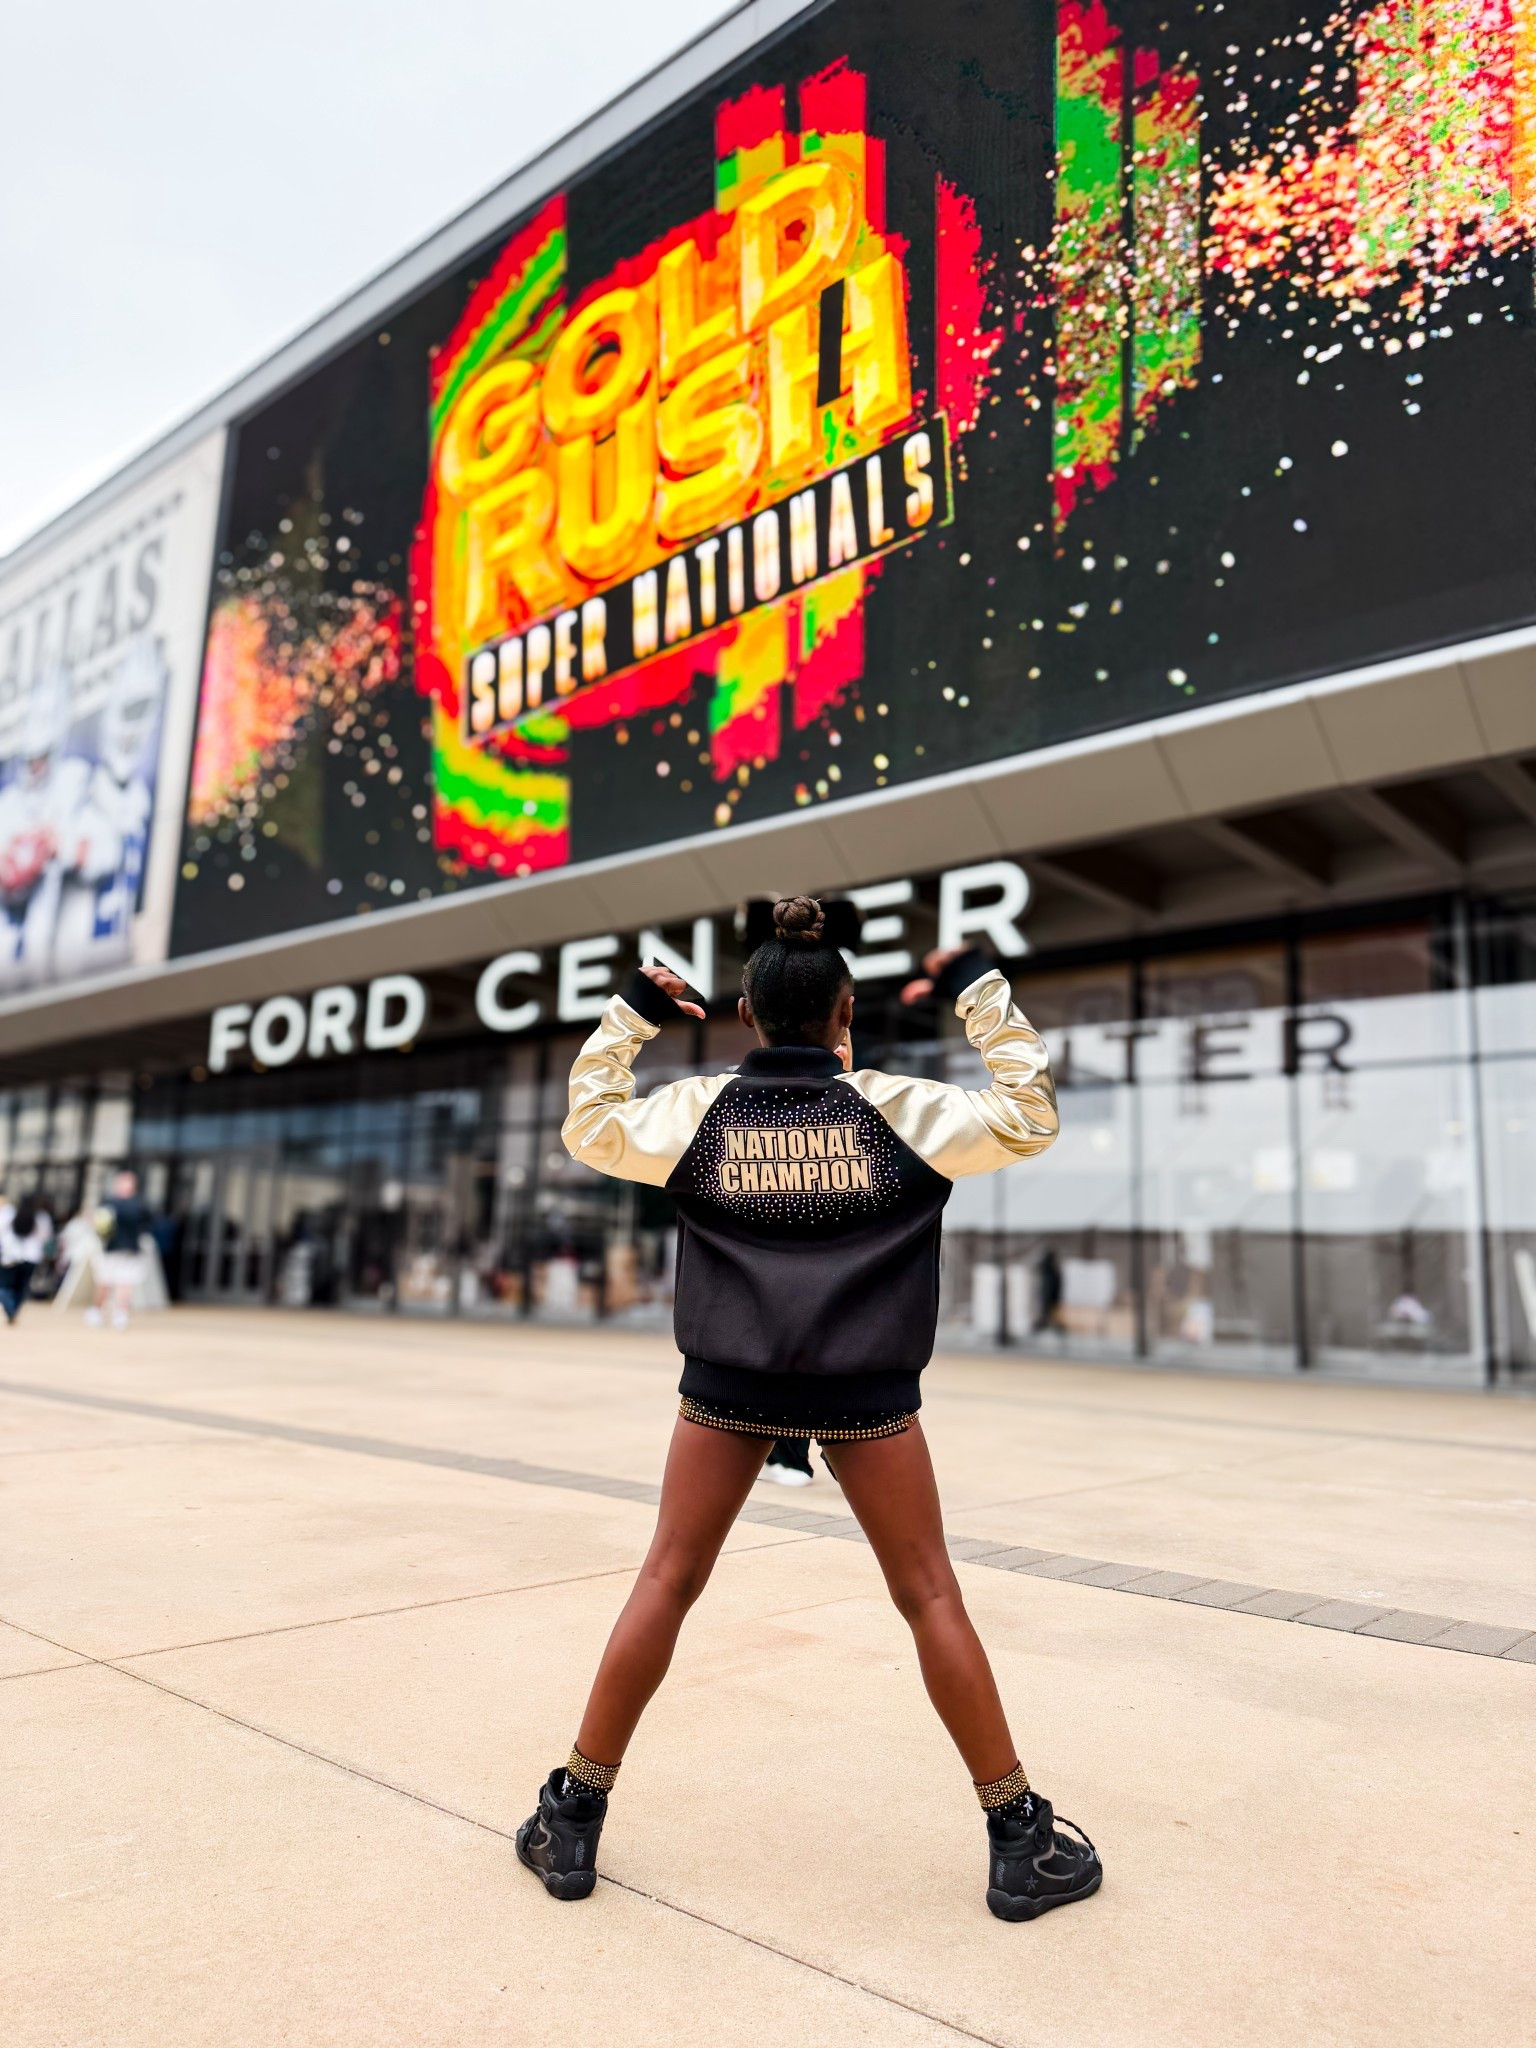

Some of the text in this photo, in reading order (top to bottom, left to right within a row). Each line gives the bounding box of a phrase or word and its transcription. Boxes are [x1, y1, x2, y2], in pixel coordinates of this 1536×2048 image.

[440, 162, 857, 494] GOLD
[463, 253, 909, 634] RUSH
[471, 431, 935, 734] SUPER NATIONALS
[208, 860, 1031, 1073] FORD CENER
[720, 1159, 871, 1194] CHAMPION
[726, 1126, 860, 1161] NATIONAL
